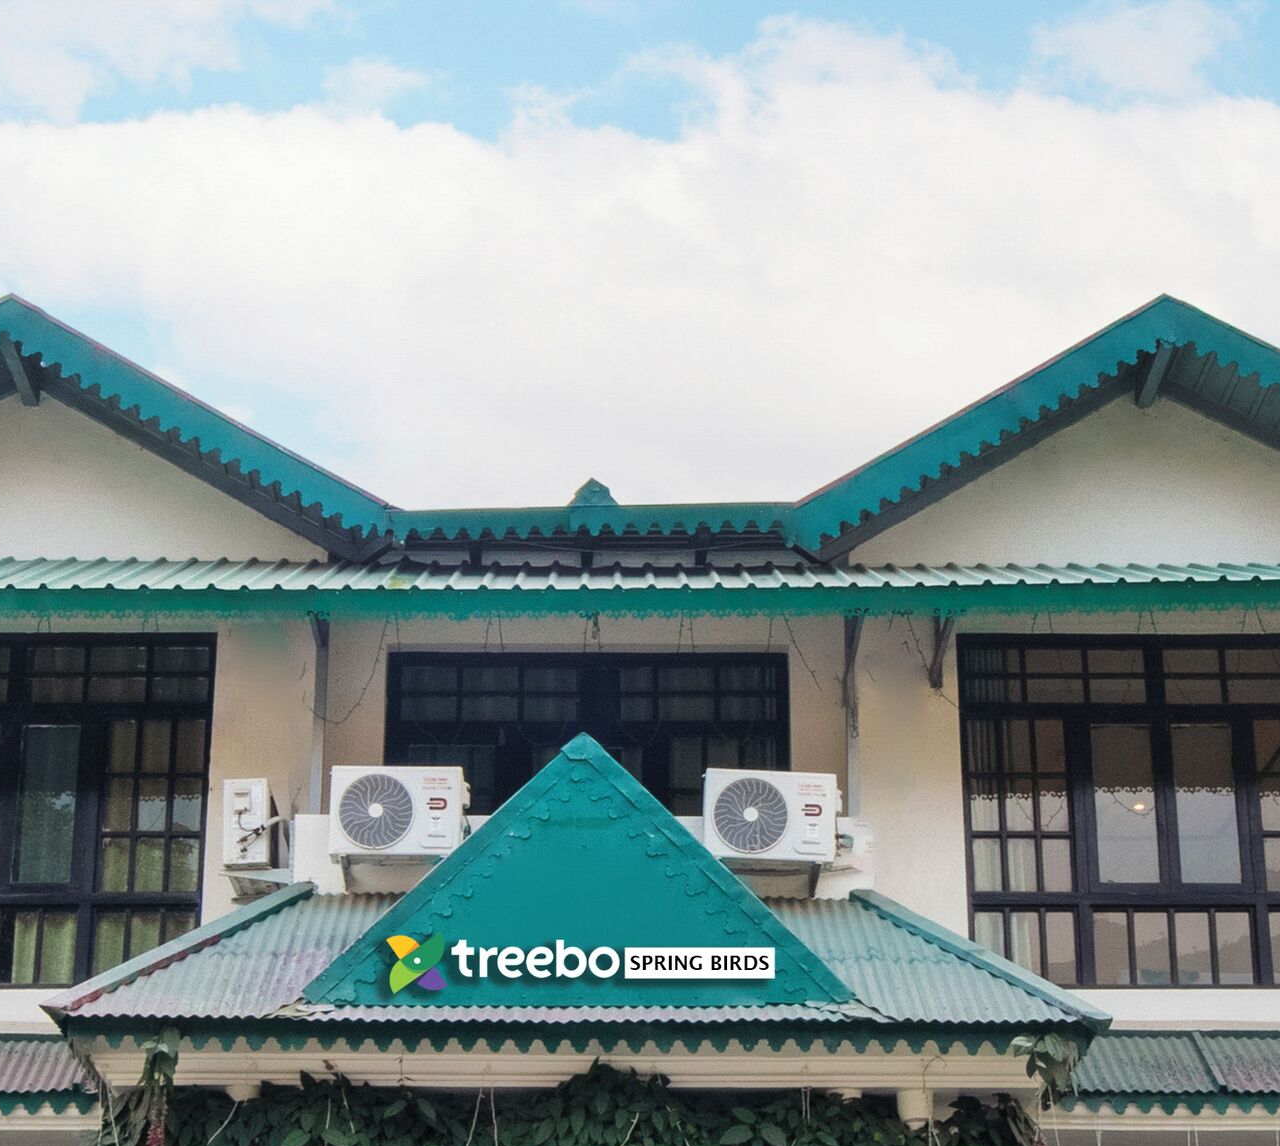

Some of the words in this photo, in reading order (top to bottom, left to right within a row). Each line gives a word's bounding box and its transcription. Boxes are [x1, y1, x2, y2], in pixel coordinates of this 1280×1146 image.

[451, 939, 620, 979] treebo
[630, 955, 703, 971] SPRING
[711, 955, 770, 971] BIRDS
